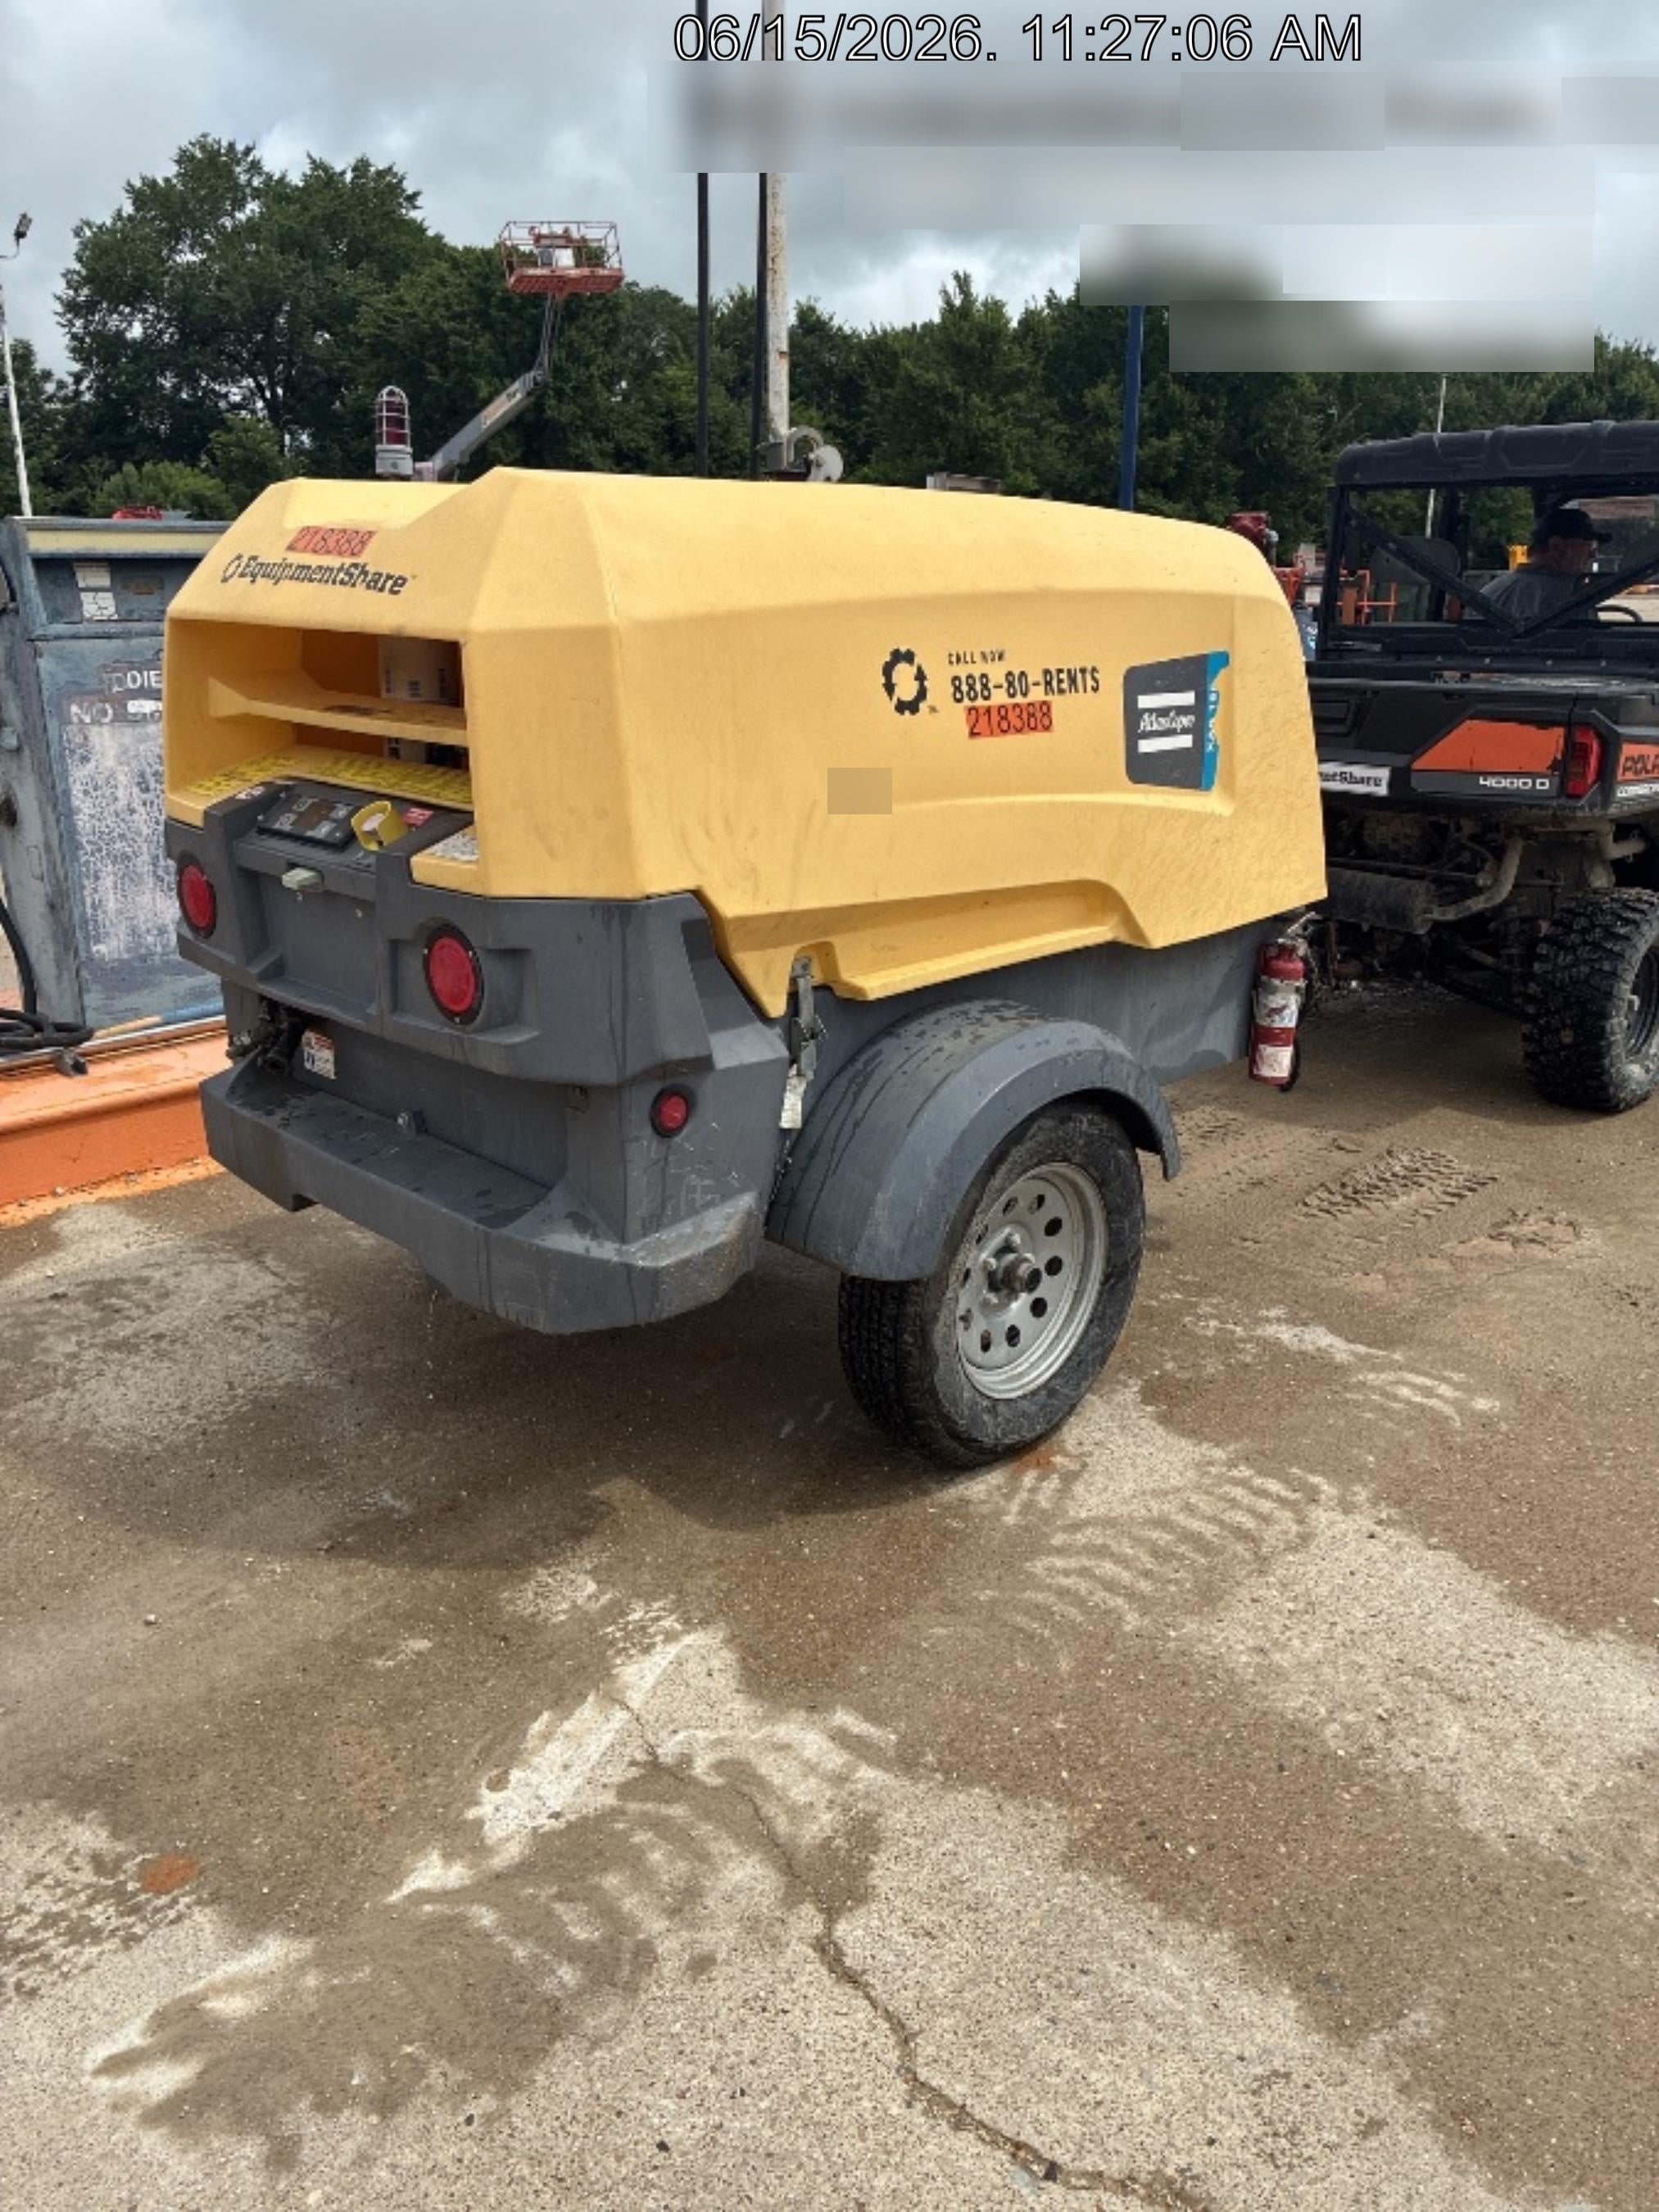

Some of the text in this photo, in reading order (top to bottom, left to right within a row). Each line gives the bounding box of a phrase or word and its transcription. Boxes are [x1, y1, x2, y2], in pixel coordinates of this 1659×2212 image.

[239, 555, 408, 595] EquipmentShare
[948, 649, 1005, 665] CALL NOW
[950, 665, 1099, 703] 888-80-RENTS
[967, 700, 1053, 737] 218388
[1480, 776, 1532, 789] 4000
